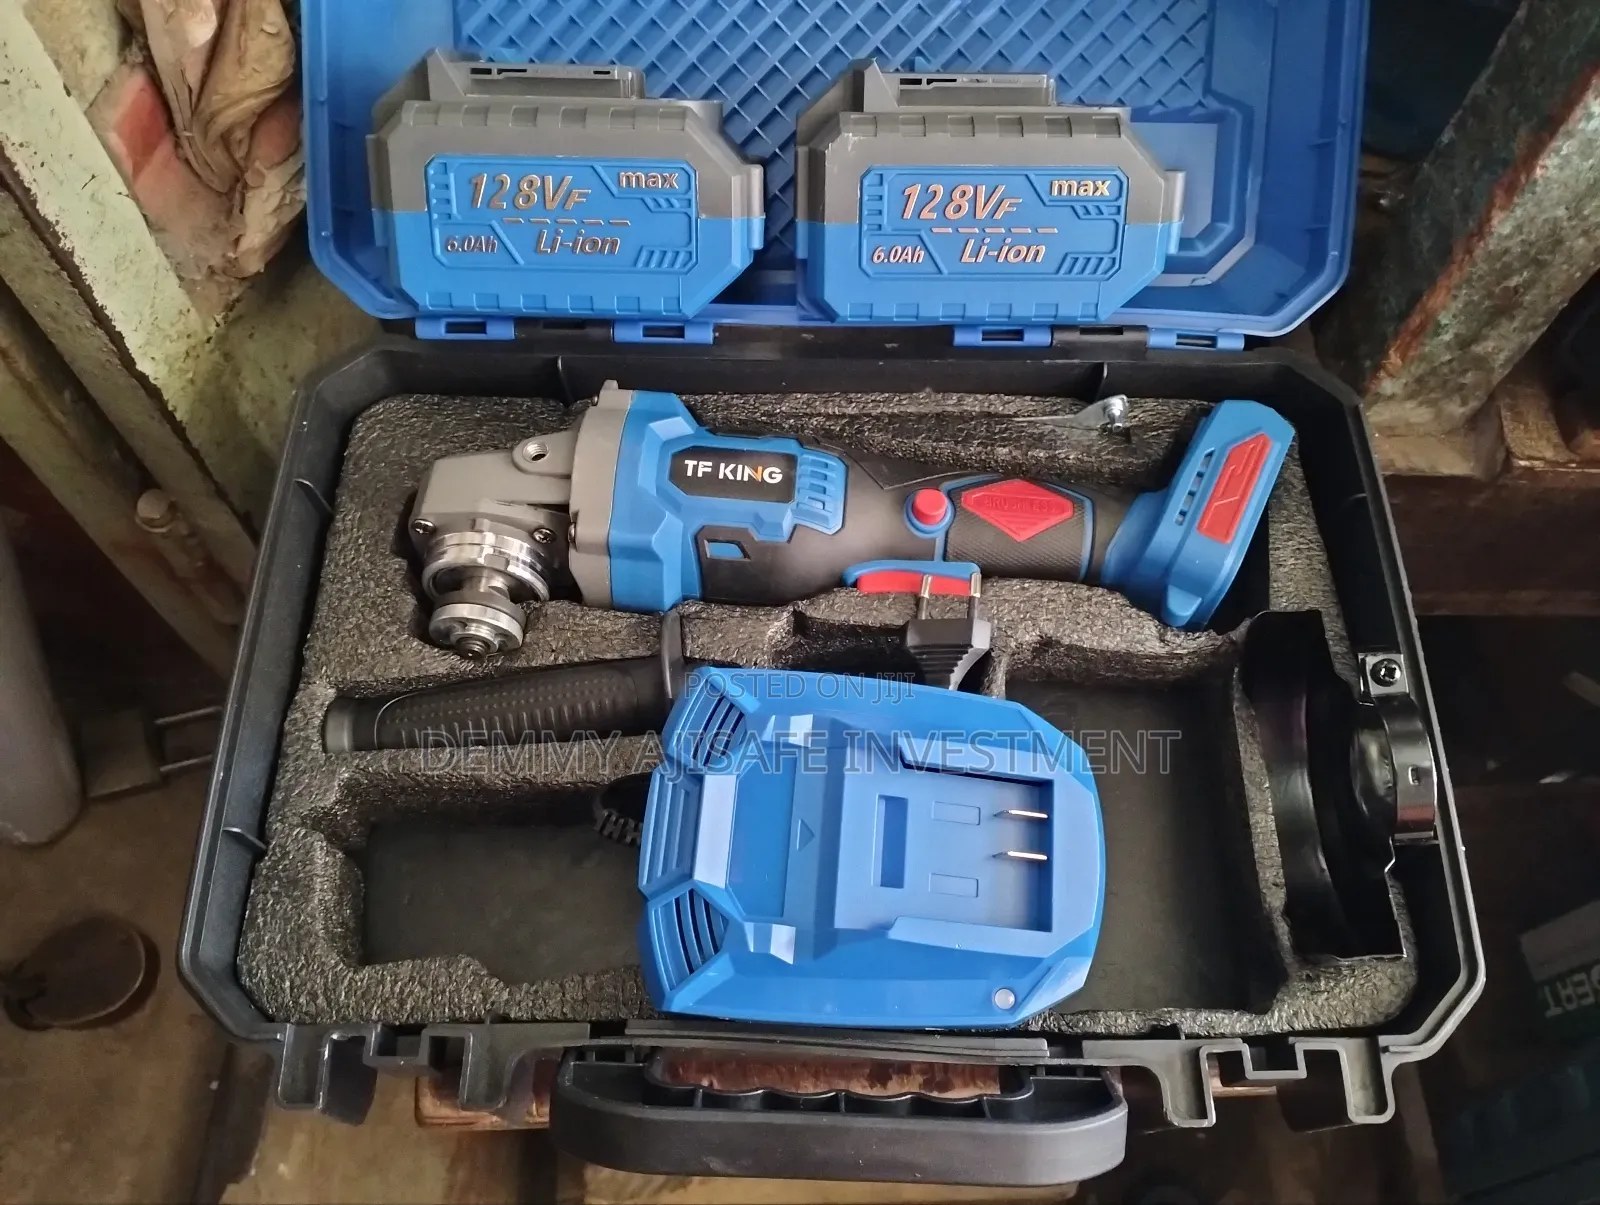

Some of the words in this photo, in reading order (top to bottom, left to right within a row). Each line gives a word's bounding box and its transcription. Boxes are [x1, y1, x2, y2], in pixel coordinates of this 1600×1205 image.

[618, 169, 680, 190] max
[1049, 178, 1110, 198] max
[445, 234, 498, 254] 6.0Ah
[535, 229, 621, 256] Li-ion
[960, 236, 1046, 264] Li-ion
[872, 244, 925, 265] 6.0Ah
[684, 459, 713, 479] TF
[718, 462, 783, 484] KING
